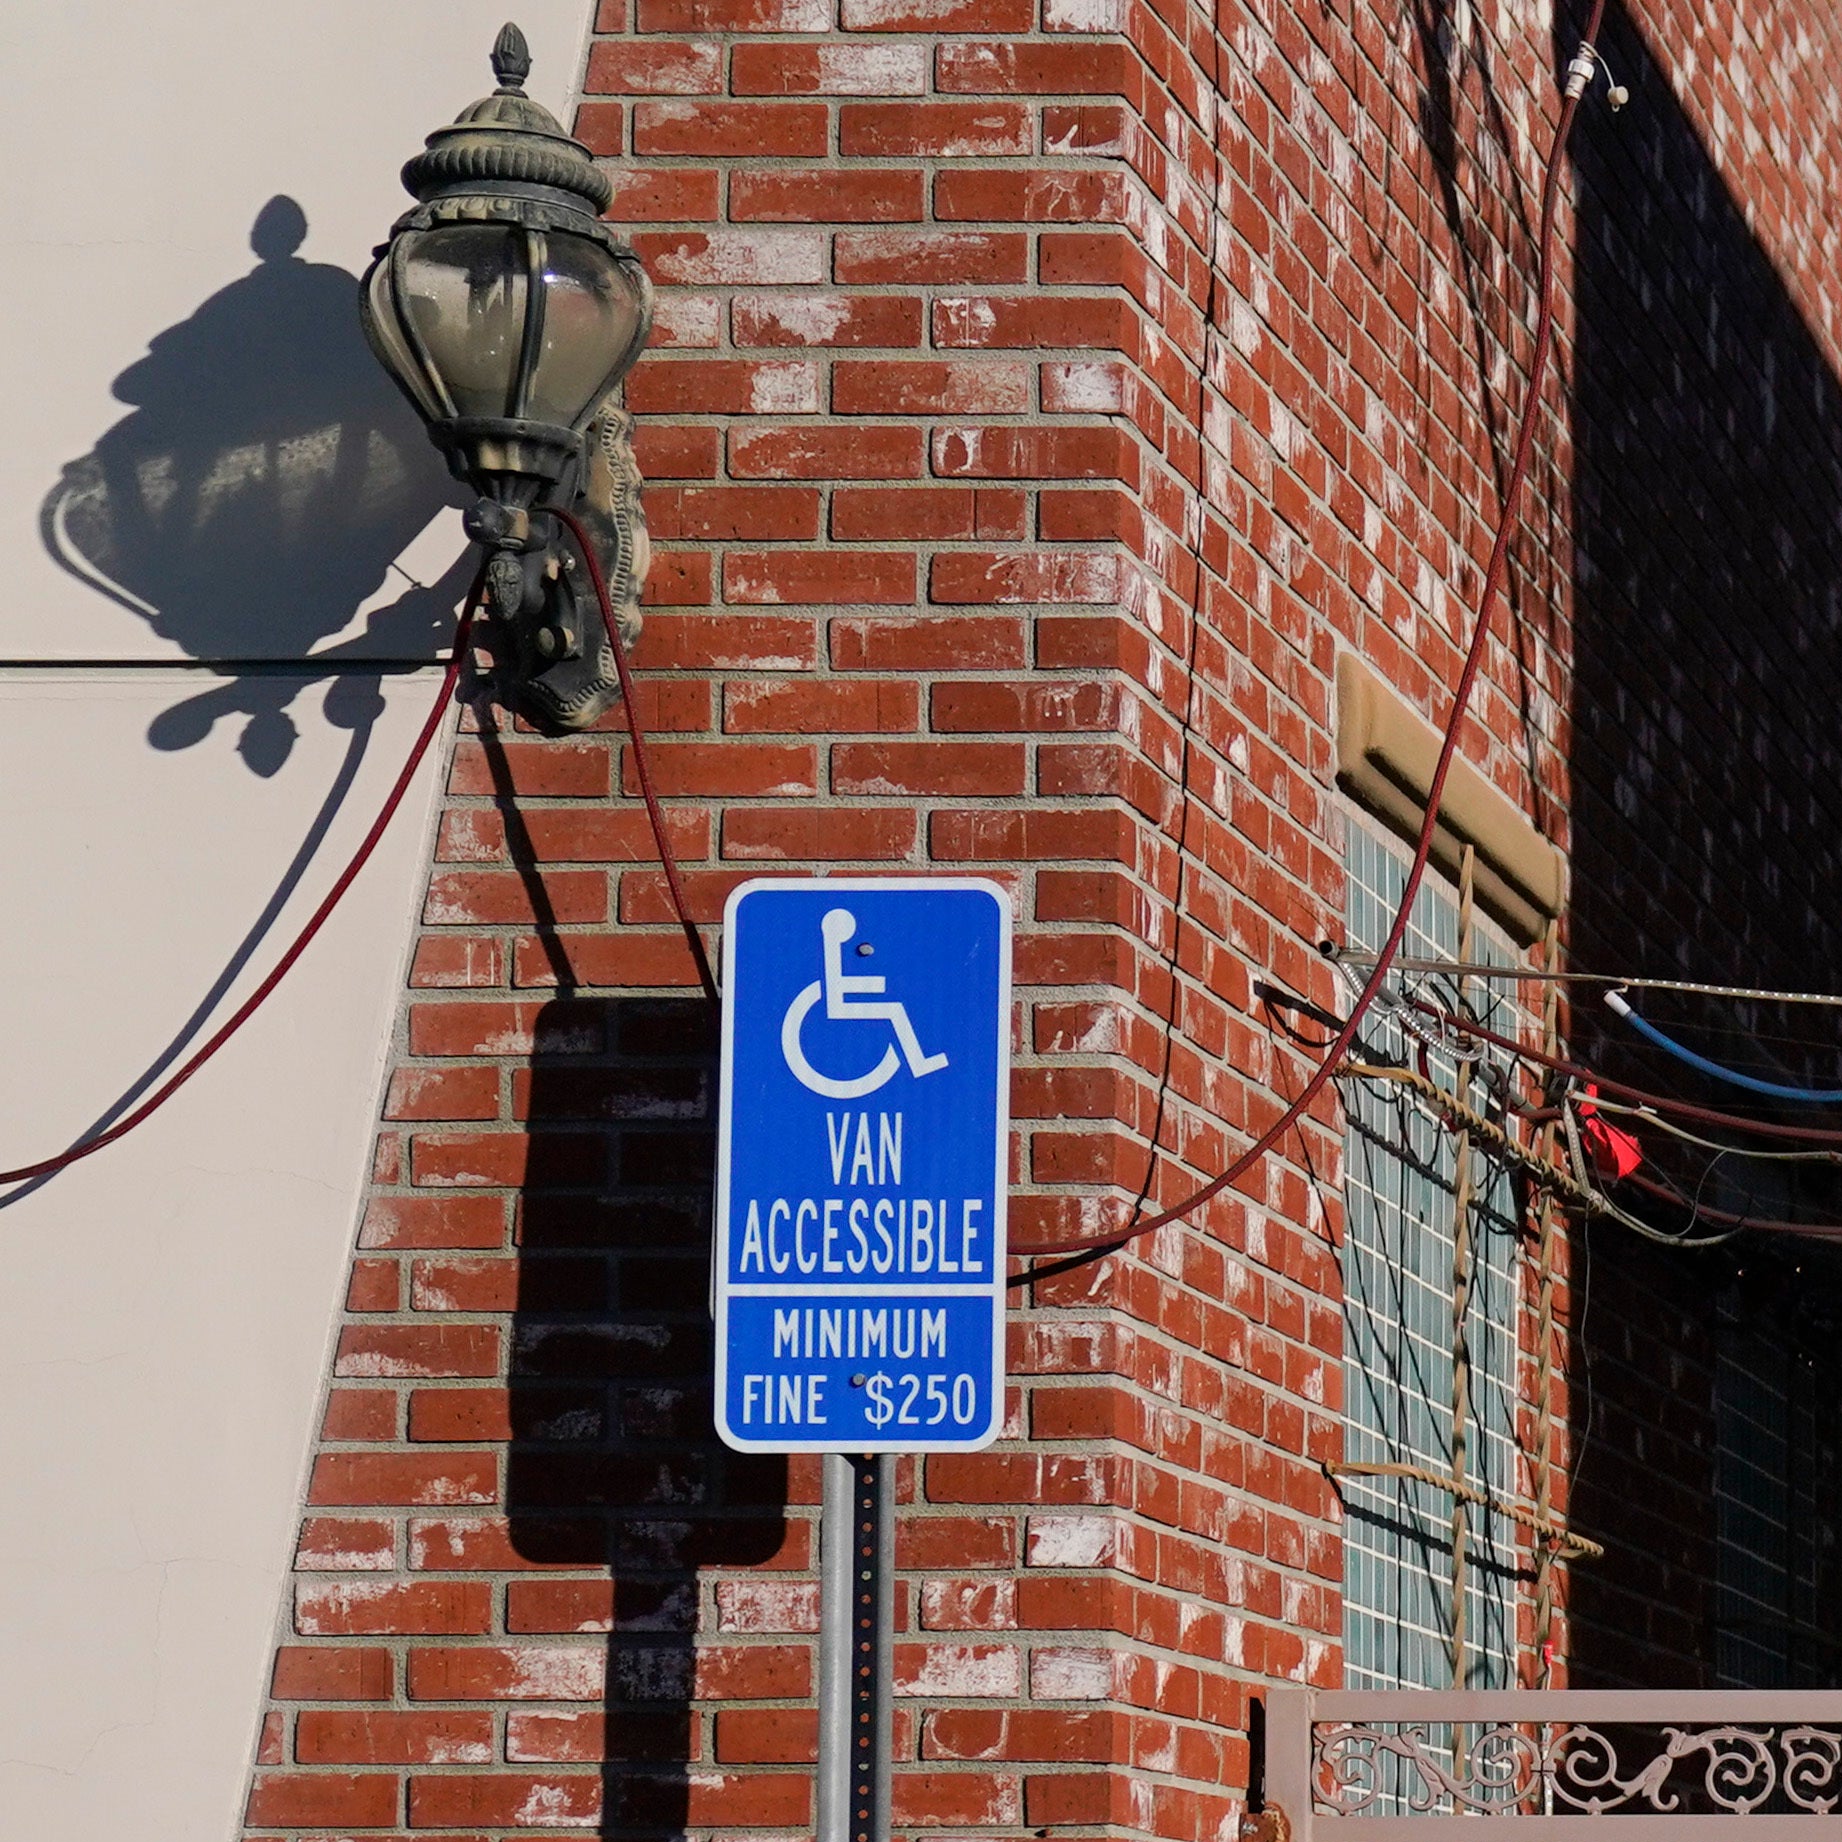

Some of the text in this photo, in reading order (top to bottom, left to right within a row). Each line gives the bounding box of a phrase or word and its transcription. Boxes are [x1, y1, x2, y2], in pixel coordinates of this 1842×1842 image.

[826, 1111, 902, 1186] VAN
[739, 1198, 984, 1274] ACCESSIBLE
[773, 1308, 947, 1359] MINIMUM
[742, 1370, 976, 1430] FINE $250
